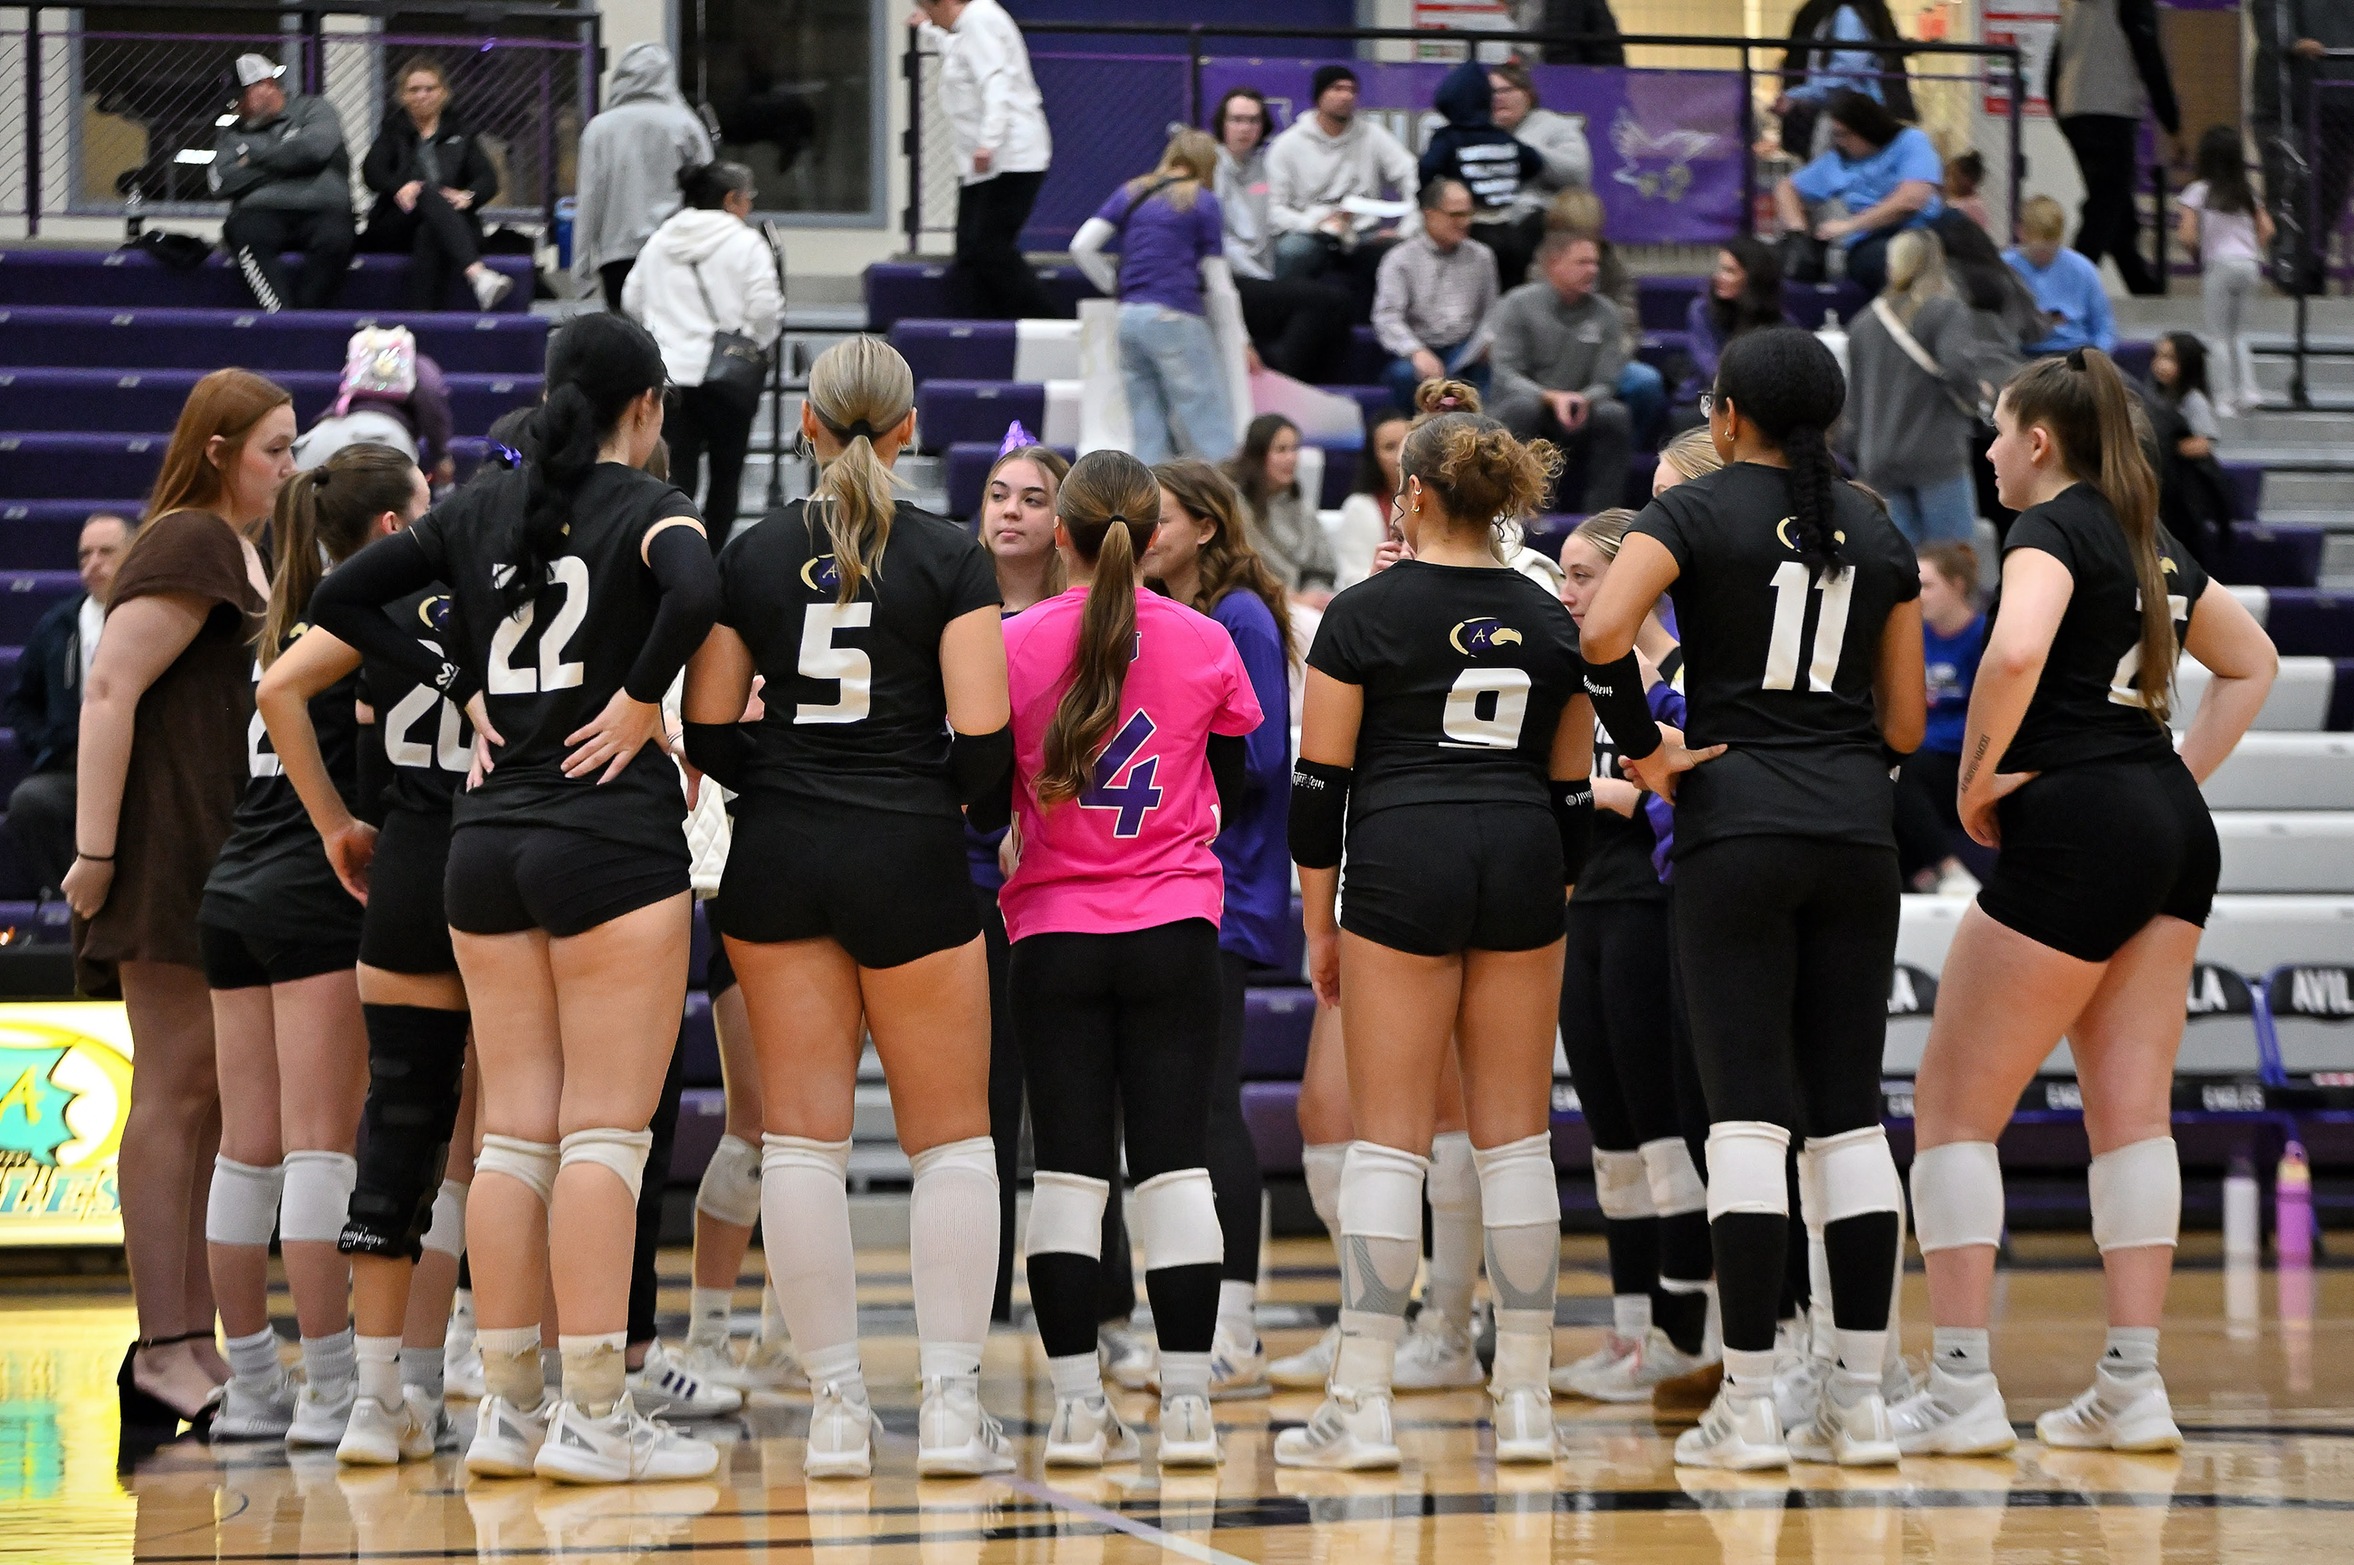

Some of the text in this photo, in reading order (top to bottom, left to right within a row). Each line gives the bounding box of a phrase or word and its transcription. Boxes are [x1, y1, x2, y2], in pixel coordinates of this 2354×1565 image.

[488, 555, 589, 695] 22
[793, 602, 872, 724] 5
[1472, 628, 1486, 643] A
[1762, 561, 1856, 692] 11
[1077, 707, 1164, 839] 4
[2292, 968, 2354, 1014] AVIL
